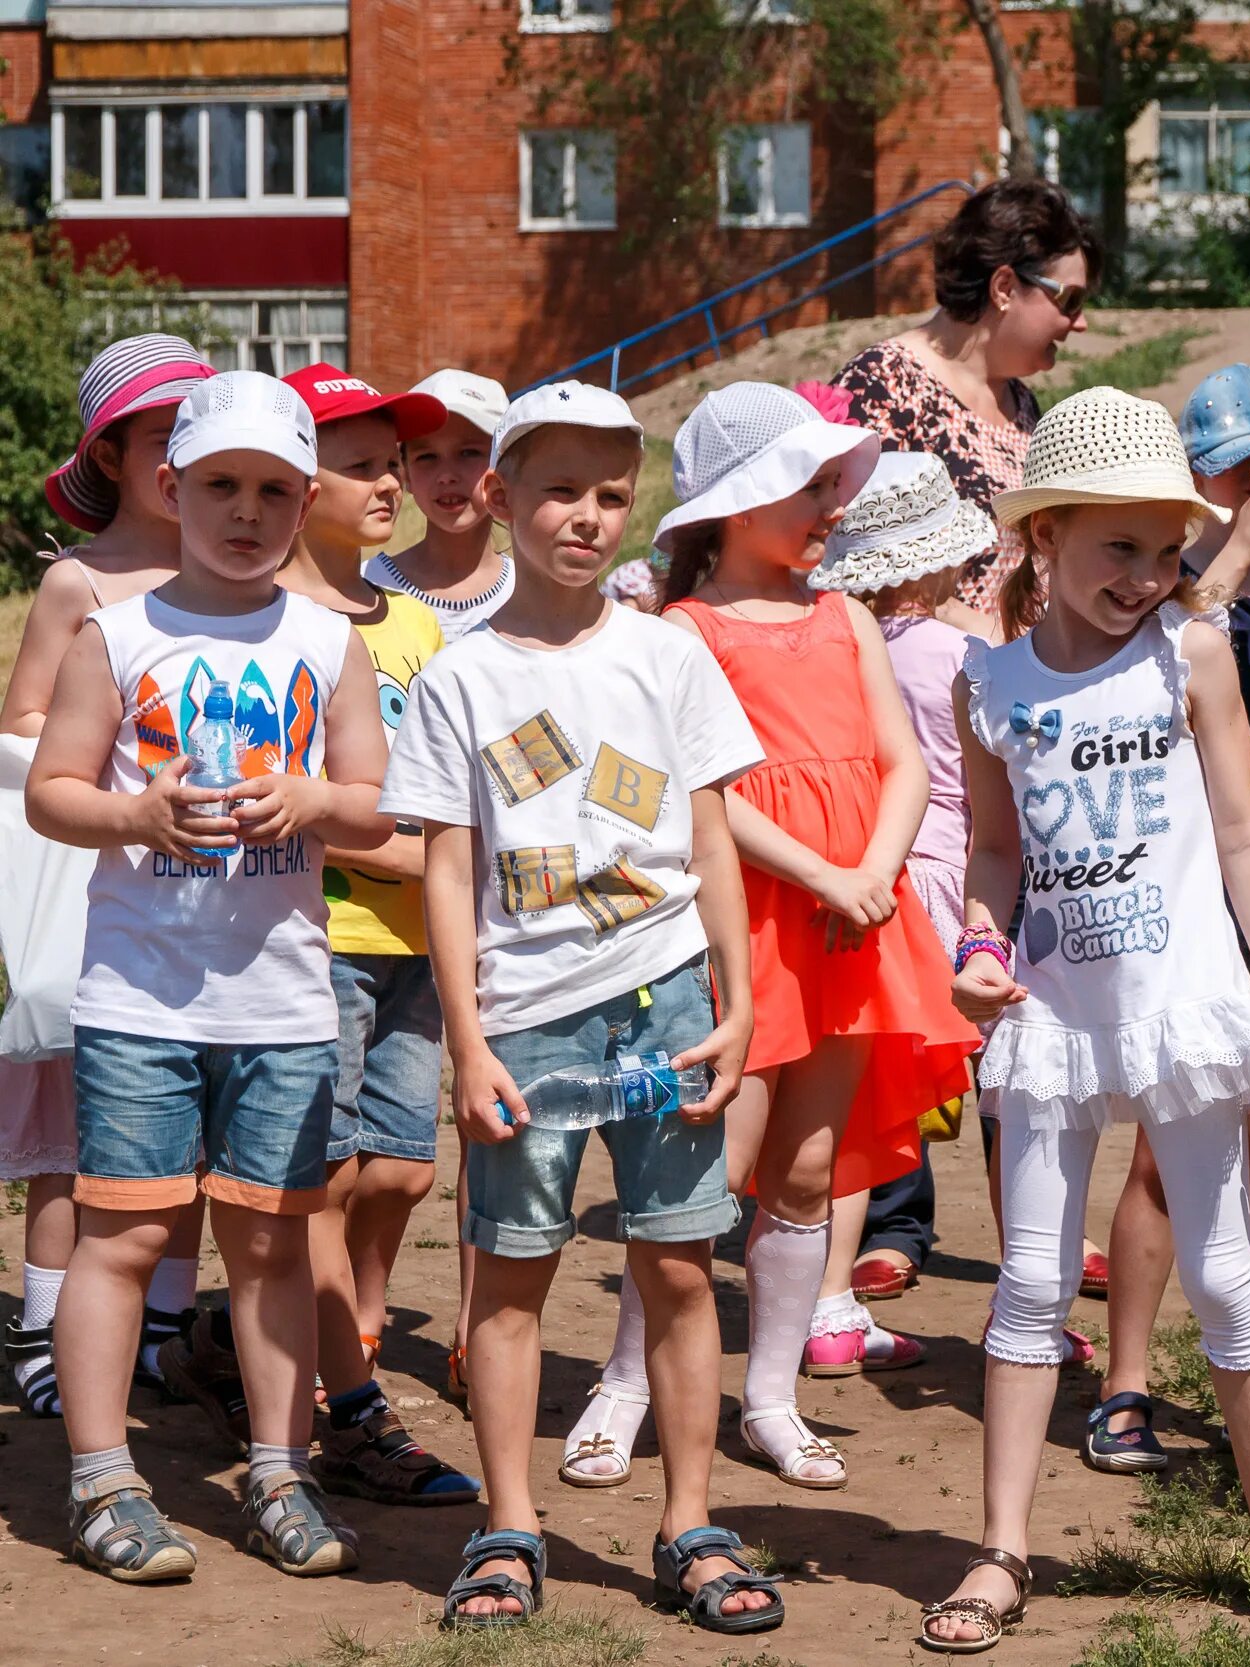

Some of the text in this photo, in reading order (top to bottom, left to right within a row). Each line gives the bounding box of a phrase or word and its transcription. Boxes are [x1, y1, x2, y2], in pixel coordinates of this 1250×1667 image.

[137, 723, 177, 753] WAVE
[1070, 721, 1101, 742] For
[1071, 730, 1169, 771] Girls
[609, 761, 641, 807] B
[1023, 843, 1148, 893] Sweet
[1059, 880, 1162, 931] Black
[1061, 916, 1169, 963] Candy
